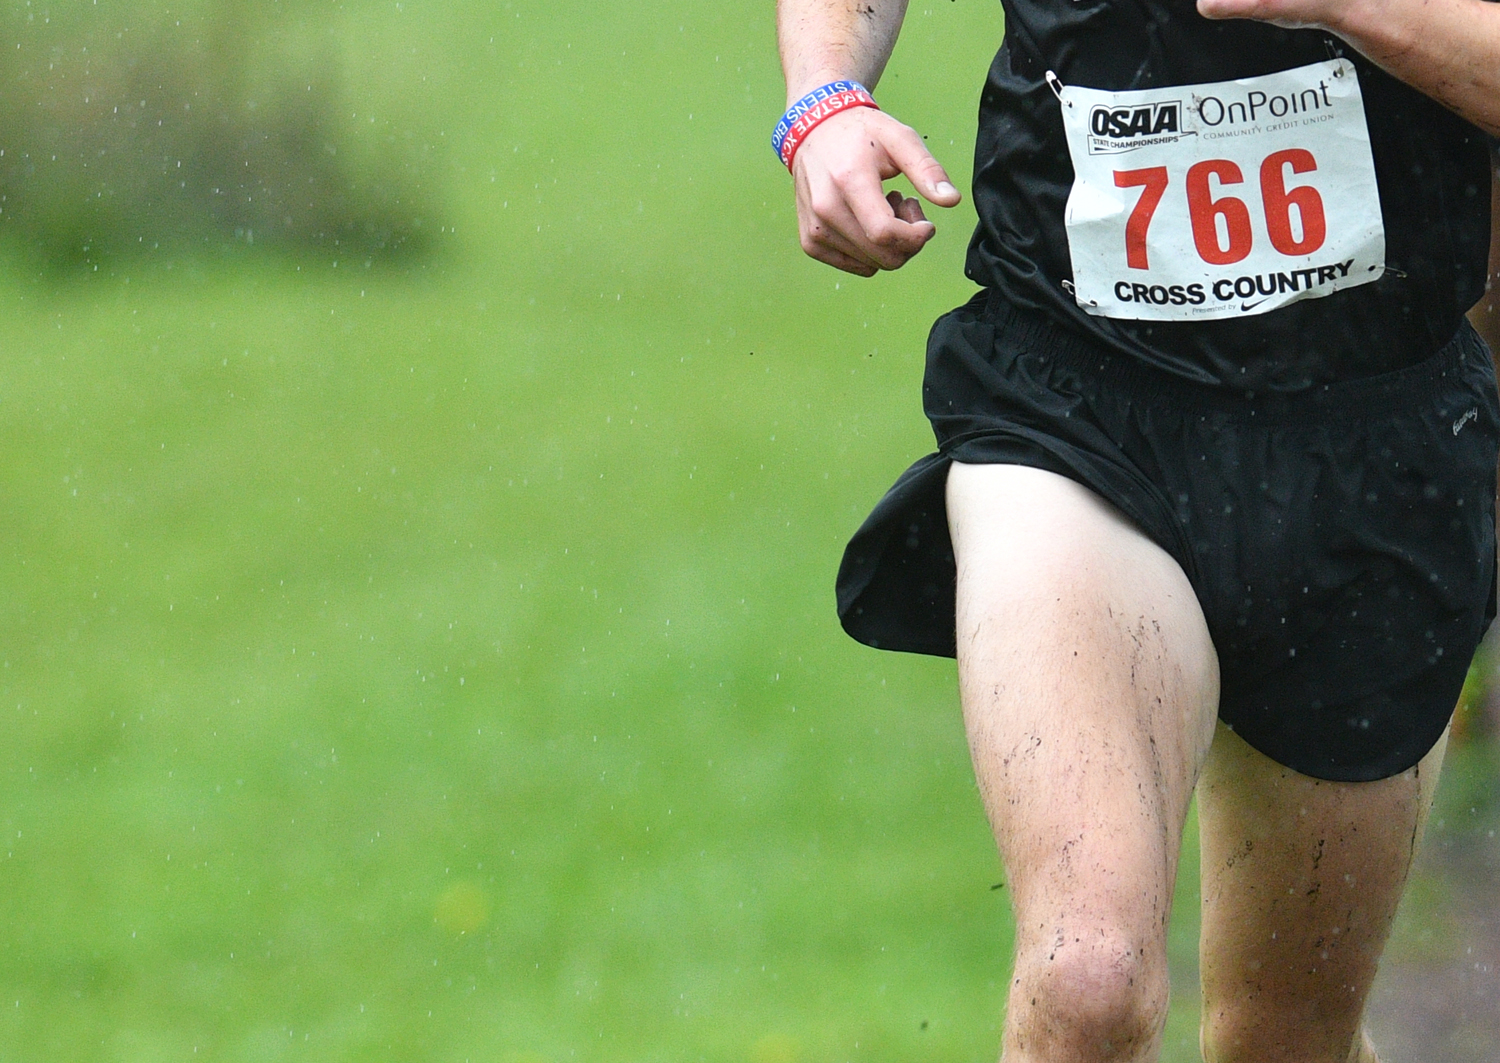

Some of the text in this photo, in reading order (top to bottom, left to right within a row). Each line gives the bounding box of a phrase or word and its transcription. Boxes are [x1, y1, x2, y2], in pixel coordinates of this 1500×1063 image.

[772, 82, 847, 148] STEENS BIG
[783, 97, 843, 154] STATE XC
[1092, 105, 1178, 138] OSAA
[1199, 80, 1332, 126] OnPoint
[1093, 136, 1179, 148] STATE CHAMPIONSHIPS
[1203, 114, 1335, 140] COMMUNITY CREDIT UNION
[1113, 148, 1326, 270] 766
[1114, 259, 1355, 305] CROSS COUNTRY
